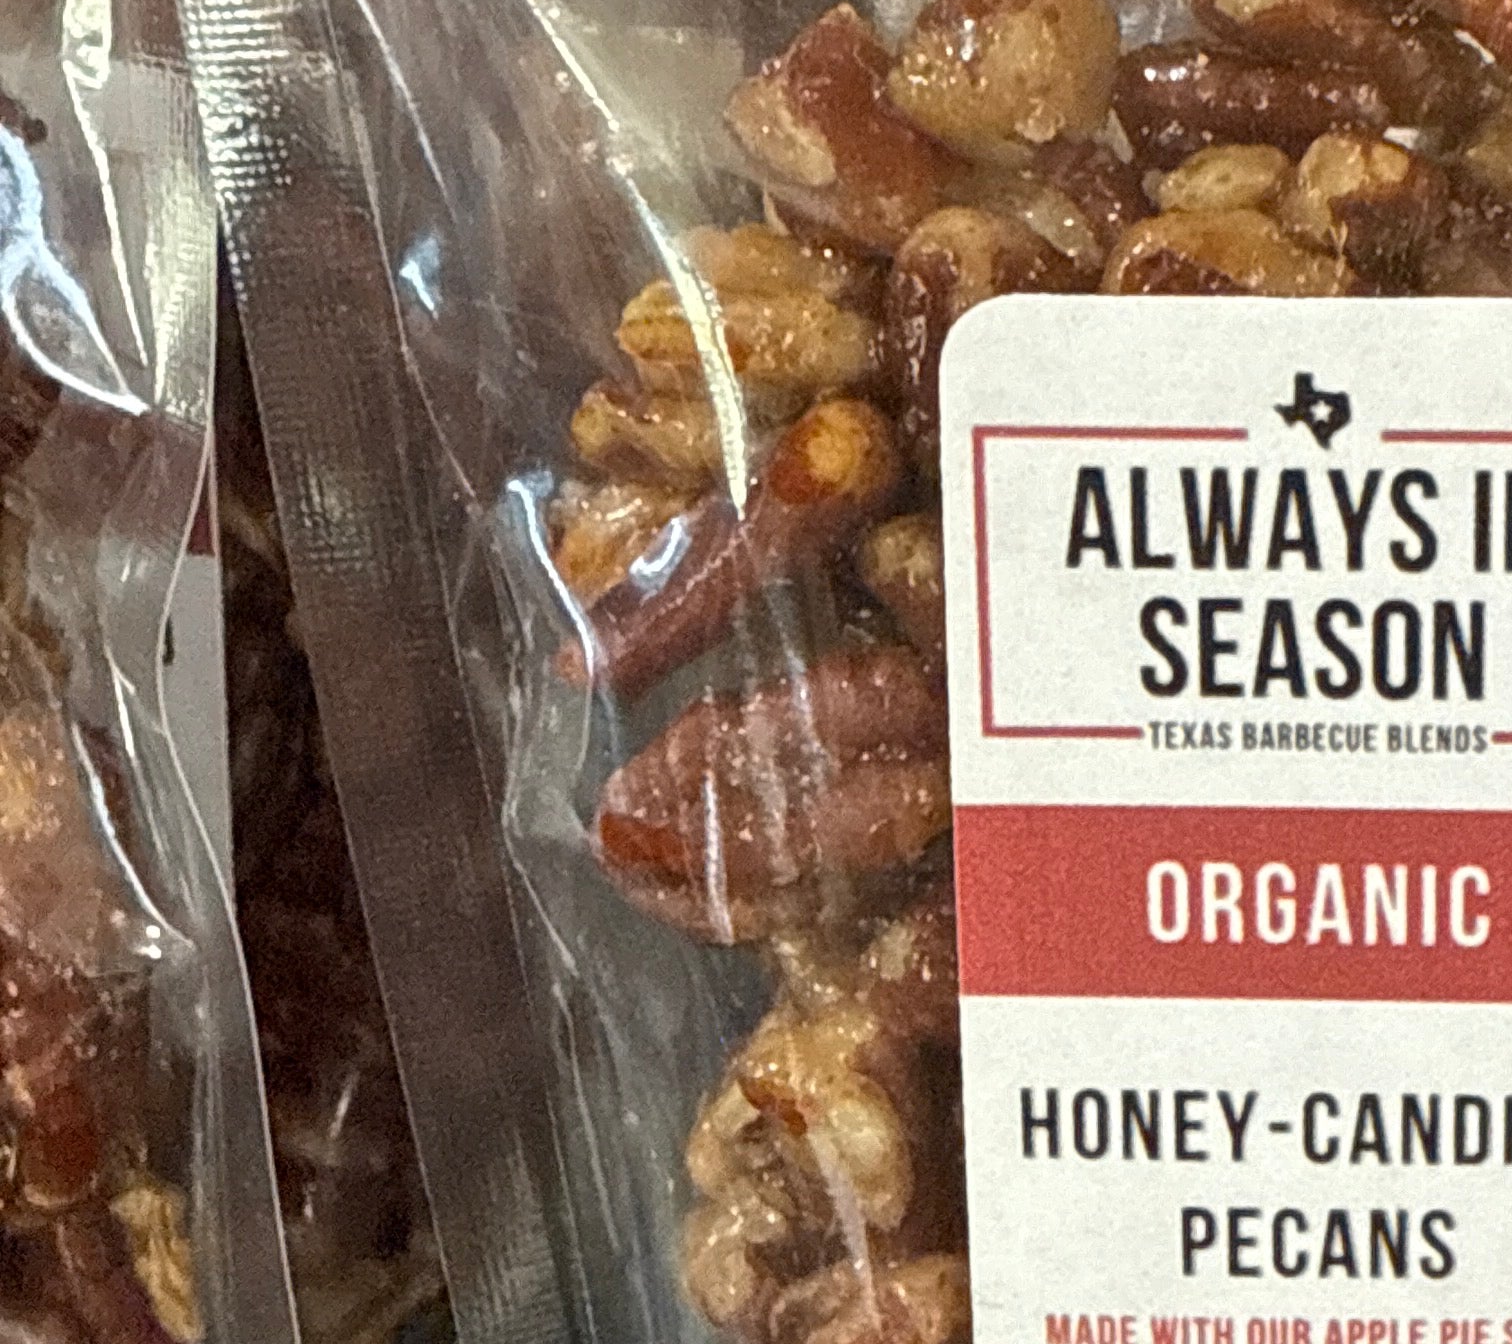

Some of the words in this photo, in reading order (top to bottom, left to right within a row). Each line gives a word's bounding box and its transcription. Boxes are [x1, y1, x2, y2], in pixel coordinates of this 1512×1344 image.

[1066, 467, 1439, 572] ALWAYS
[1139, 597, 1486, 701] SEASON
[1149, 721, 1233, 751] TEXAS
[1242, 722, 1378, 753] BARBECUE
[1387, 724, 1488, 754] BLENDS
[1146, 860, 1491, 948] ORGANIC
[1180, 1207, 1458, 1279] PECANS
